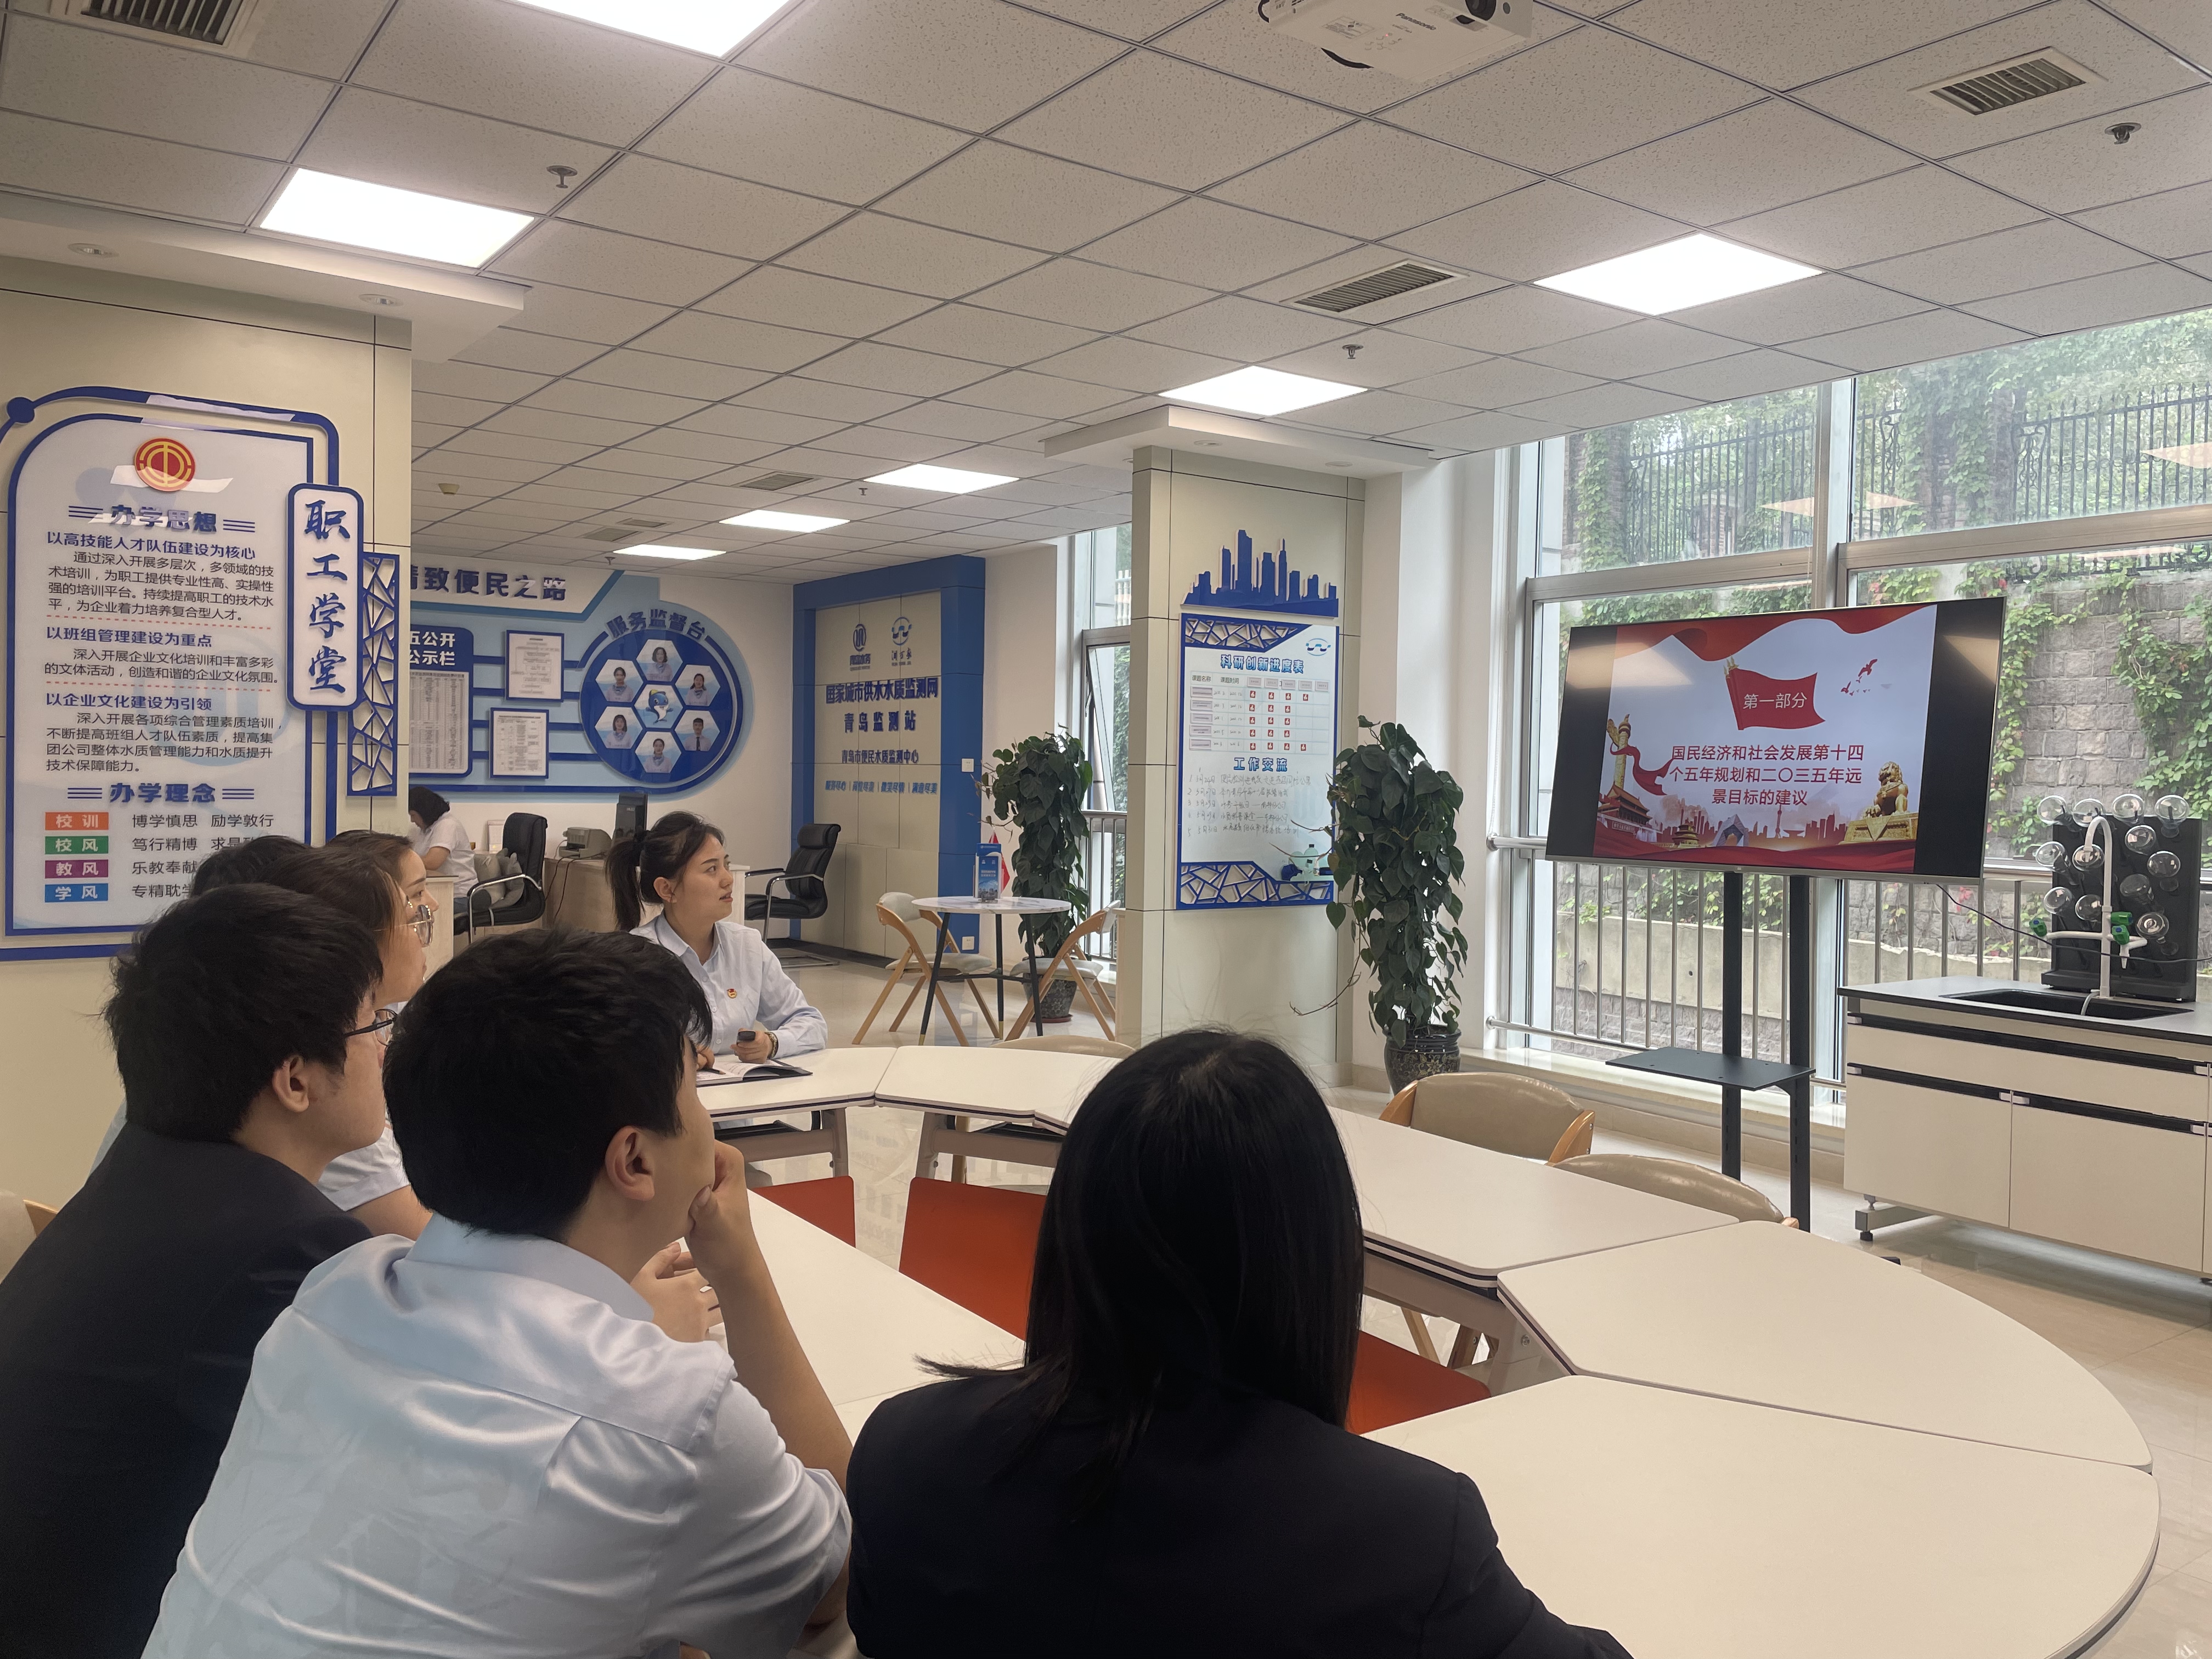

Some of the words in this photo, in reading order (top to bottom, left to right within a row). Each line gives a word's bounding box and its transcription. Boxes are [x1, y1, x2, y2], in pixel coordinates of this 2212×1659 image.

[111, 504, 217, 533] 办学思想
[47, 531, 256, 560] 以高技能人才队伍建设为核心
[73, 551, 274, 578] 通过深入开展多层次，多领域的技
[48, 566, 274, 592] 术培训，为职工提供专业性高、实操性
[48, 582, 274, 608] 强的培训平台。持续提高职工的技术水
[304, 499, 351, 693] 职工学堂
[48, 598, 243, 622] 平，为企业着力培养复合型人才。
[607, 608, 707, 640] 服务监督台
[46, 627, 213, 648] 以班组管理建设为重点
[73, 648, 274, 669] 深入开展企业文化培训和丰富多彩
[410, 649, 455, 666] 公示栏
[1220, 654, 1305, 674] 科研创新进度表
[44, 663, 279, 684] 的文体活动，创造和谐的企业文化氛围。
[826, 677, 939, 704] 国家城市供水水质监测网
[46, 693, 212, 712] 以企业文化建设为引领
[1742, 692, 1809, 710] 第一部分
[77, 712, 282, 730] 深入开展各项综合管理素质培训，
[844, 710, 917, 733] 青岛监测站
[46, 727, 274, 744] 不断提高班组人才队伍素质，提高集
[46, 743, 273, 759] 团公司整体水质管理能力和水质提升
[841, 749, 919, 764] 青岛市便民水质监测中心
[1671, 743, 1865, 762] 国民经济和社会发展第十四
[46, 759, 140, 772] 技术保障能力。
[1233, 758, 1288, 772] 工作交流
[109, 782, 216, 803] 办学理念
[1712, 788, 1809, 806] 景目标的建议
[132, 814, 198, 828] 博学慎思
[211, 814, 274, 828] 励学敦行
[132, 837, 198, 851] 笃行精博
